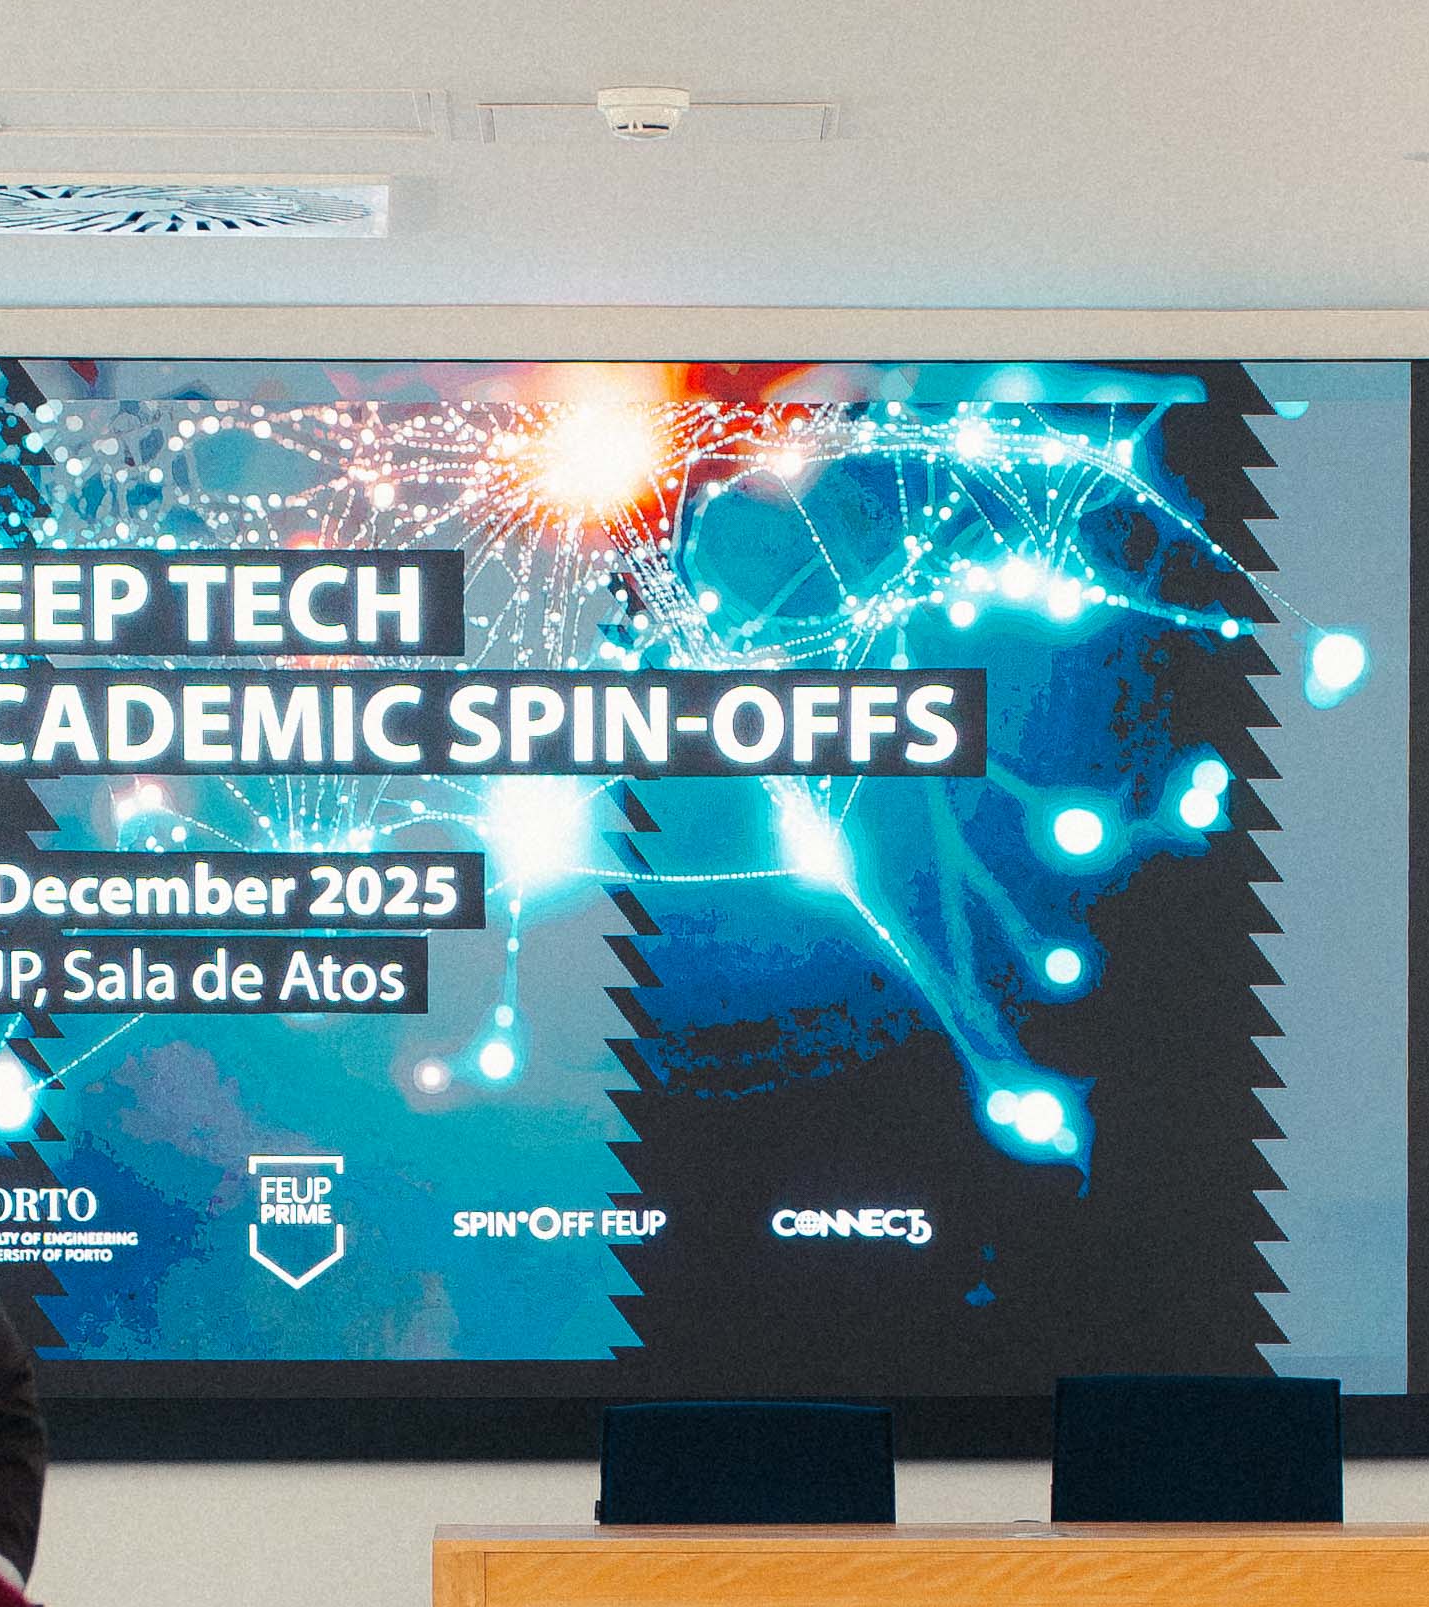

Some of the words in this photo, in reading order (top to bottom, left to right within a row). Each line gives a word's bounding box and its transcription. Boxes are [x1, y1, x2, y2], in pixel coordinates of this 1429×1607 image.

[168, 564, 420, 643] TECH
[448, 684, 958, 764] SPIN-OFFS
[308, 865, 458, 916] 2025
[63, 947, 176, 1001] Sala
[192, 947, 264, 1002] de
[278, 950, 405, 1002] Atos
[260, 1176, 332, 1203] FEUP
[260, 1203, 332, 1225] PRIME
[602, 1209, 667, 1236] FEUP
[20, 1231, 42, 1246] OF
[43, 1231, 139, 1246] ENGINEERING
[42, 1248, 63, 1262] OF
[64, 1248, 113, 1262] PORTO
